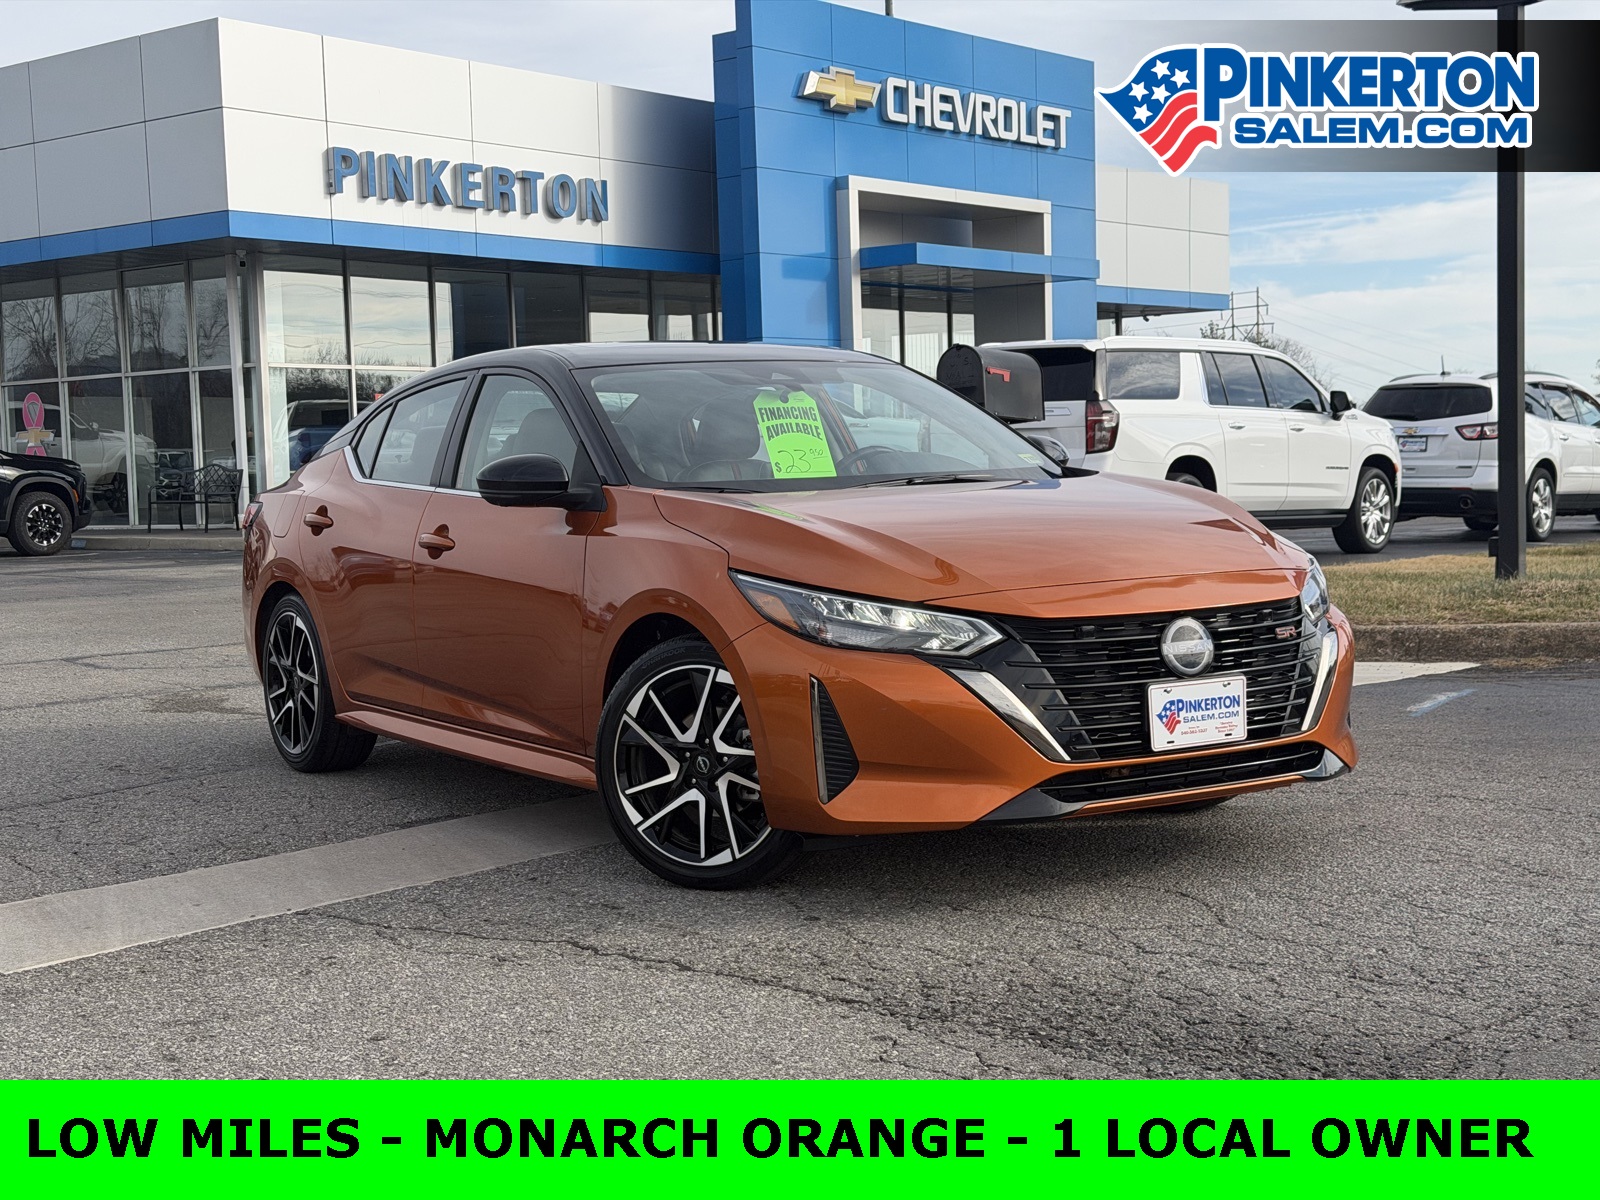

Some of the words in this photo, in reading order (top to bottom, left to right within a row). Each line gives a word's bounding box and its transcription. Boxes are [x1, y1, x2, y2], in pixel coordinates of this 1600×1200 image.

[882, 77, 1072, 149] CHEVROLET
[328, 146, 609, 221] PINKERTON
[758, 406, 818, 423] FINANCING
[765, 422, 823, 442] AVAILABLE
[1275, 625, 1297, 639] SR
[1164, 642, 1213, 653] NISSAN
[1176, 694, 1241, 718] PINKERTON
[1183, 710, 1240, 724] SALEM.COM
